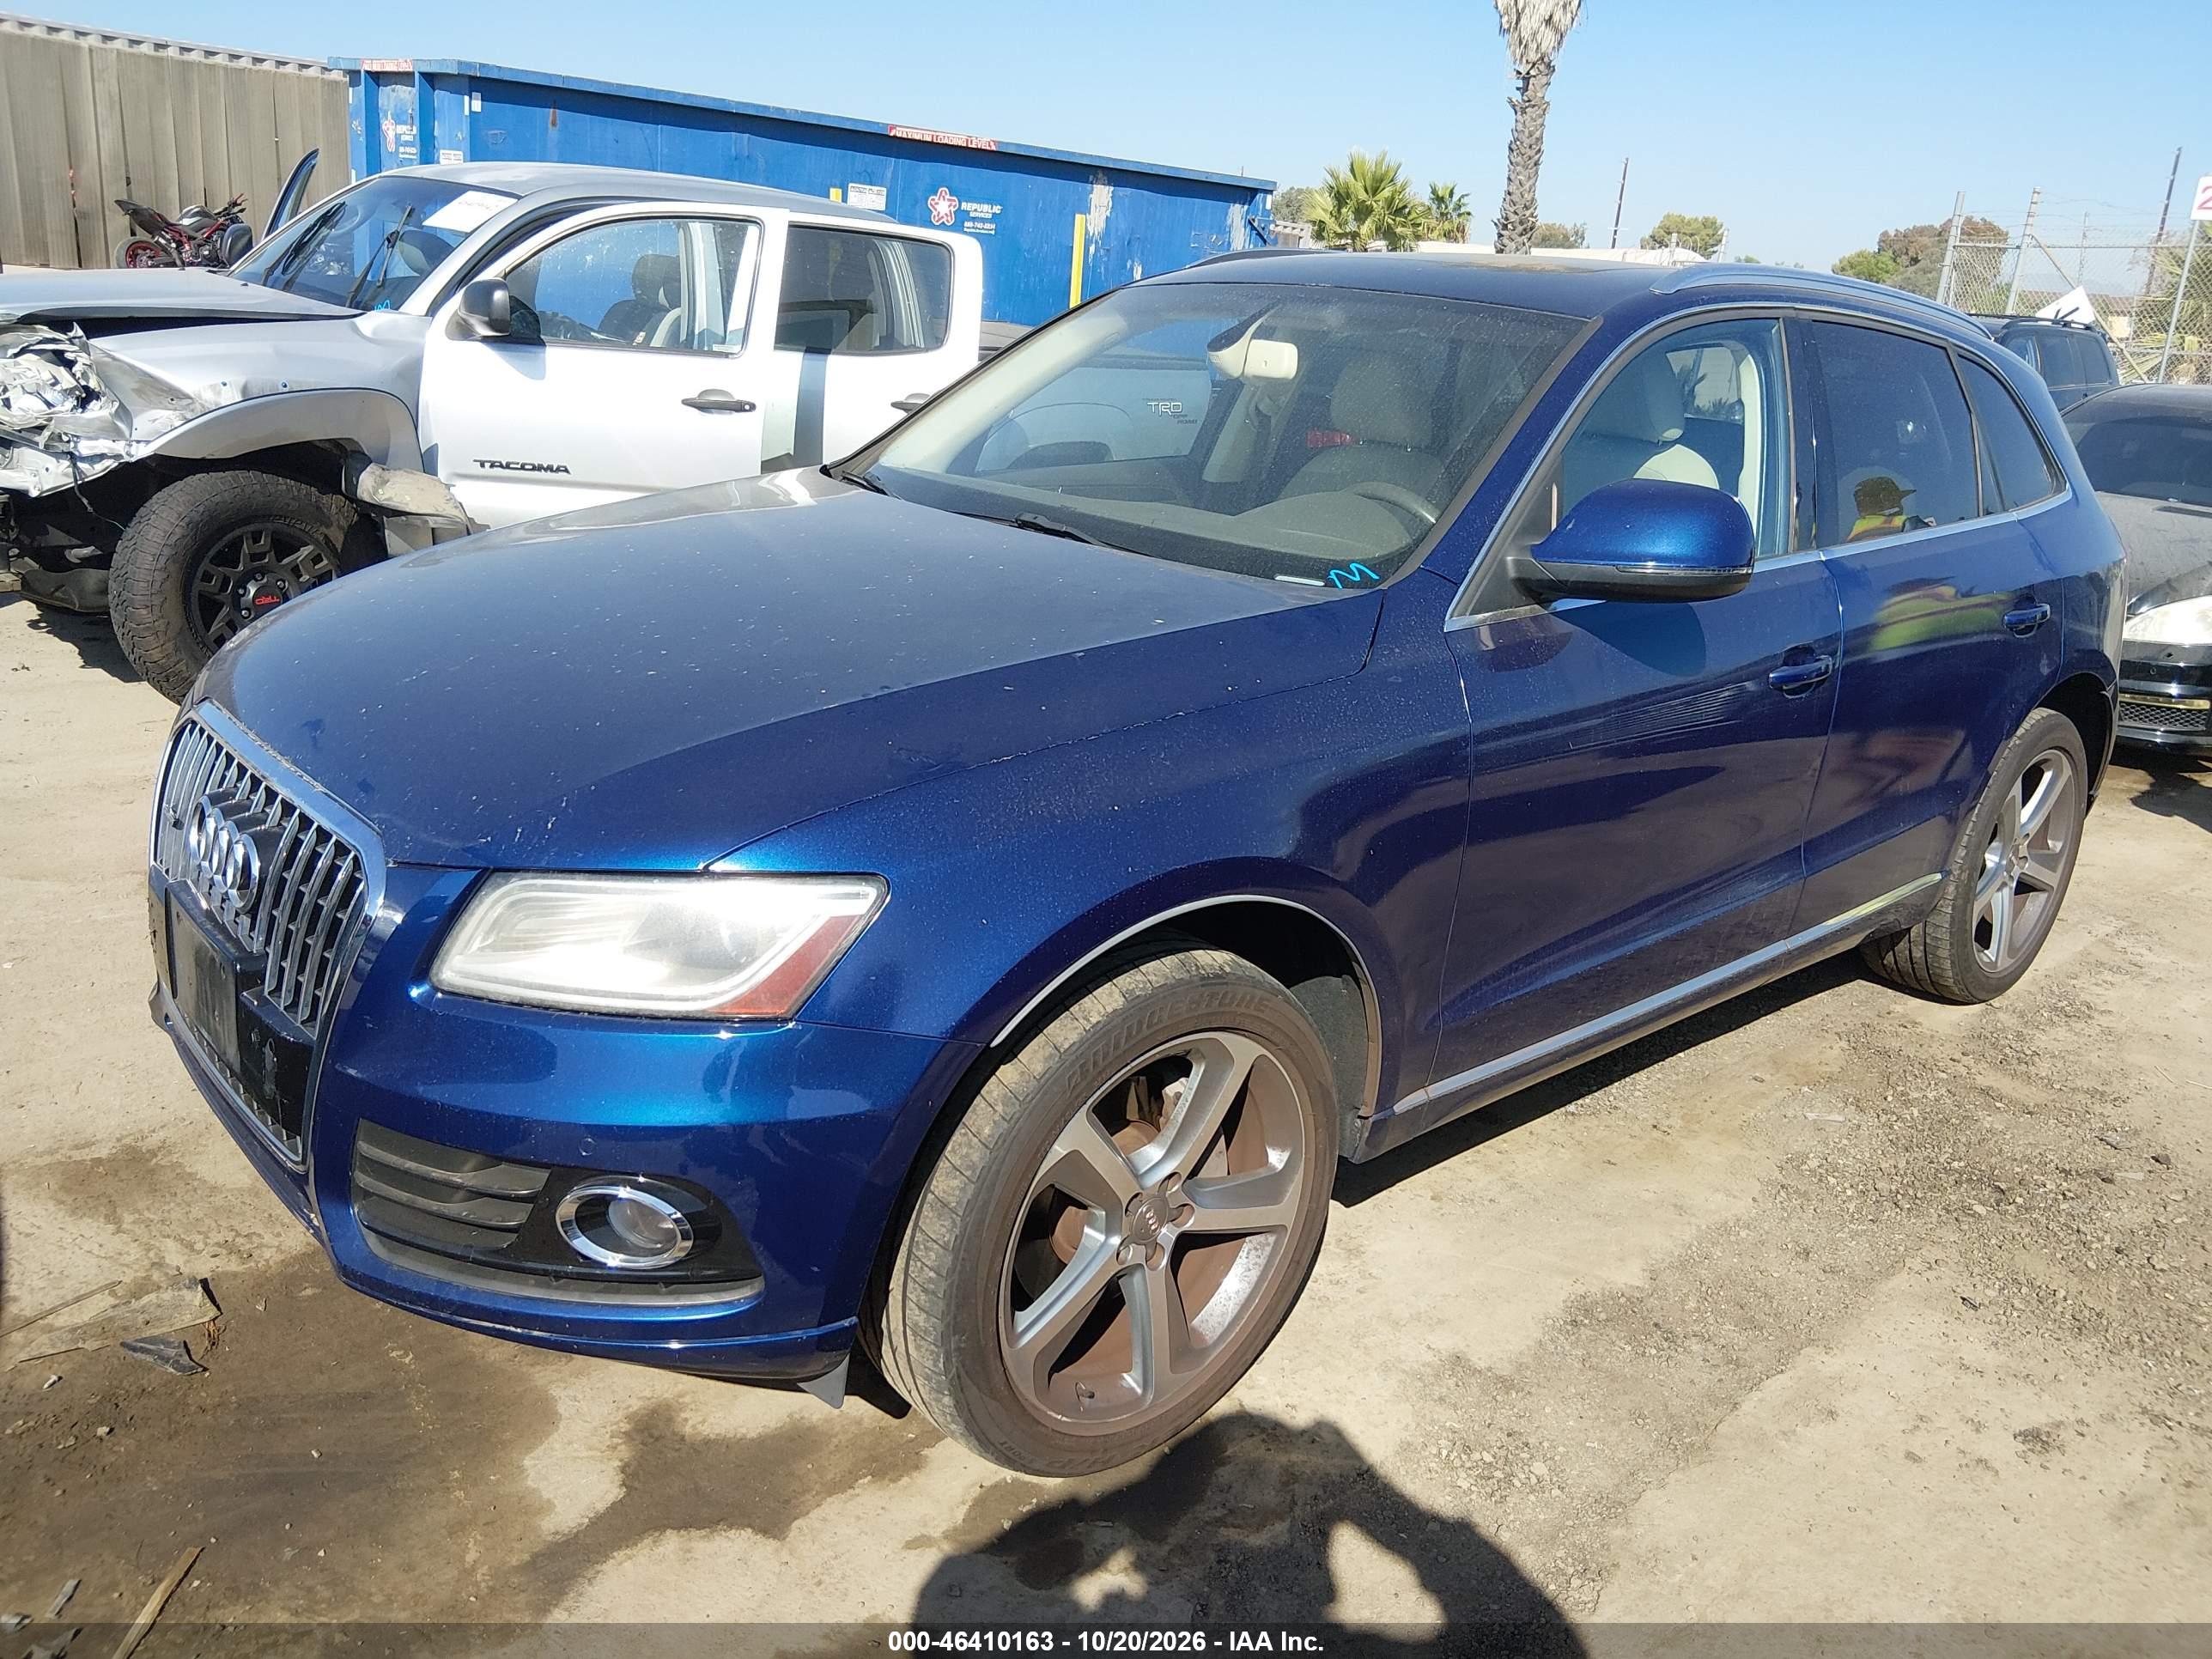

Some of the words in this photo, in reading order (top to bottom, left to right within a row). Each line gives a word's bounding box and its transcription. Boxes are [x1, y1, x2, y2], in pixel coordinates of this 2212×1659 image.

[933, 134, 967, 147] LOADING
[961, 201, 1001, 214] REPUBLIC
[1146, 402, 1182, 416] TRD
[472, 459, 571, 475] TACOMA
[1327, 562, 1380, 589] M
